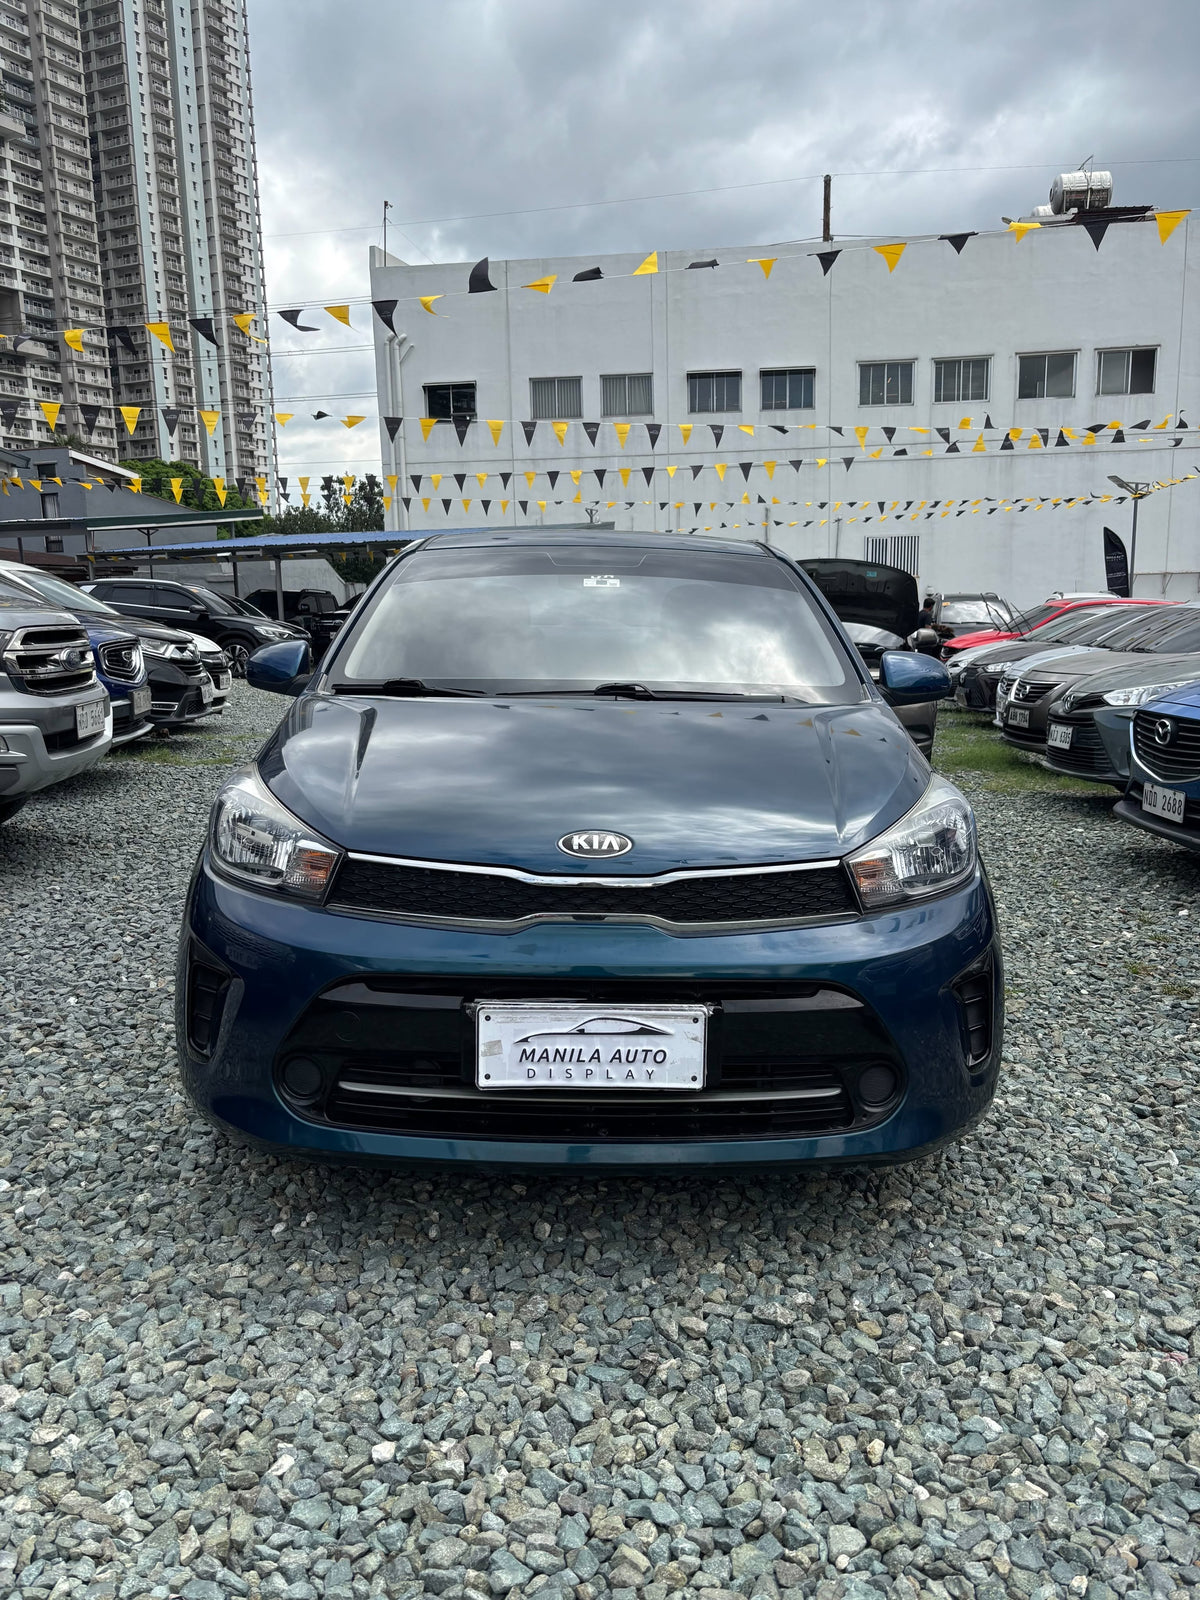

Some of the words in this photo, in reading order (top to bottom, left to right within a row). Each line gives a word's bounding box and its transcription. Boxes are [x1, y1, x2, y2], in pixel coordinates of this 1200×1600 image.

[1143, 789, 1158, 808] NDD
[1161, 794, 1183, 816] 2688
[572, 834, 620, 850] KIA
[519, 1047, 601, 1064] MANILA
[610, 1048, 668, 1064] AUTO
[527, 1068, 655, 1080] DISPLAY
